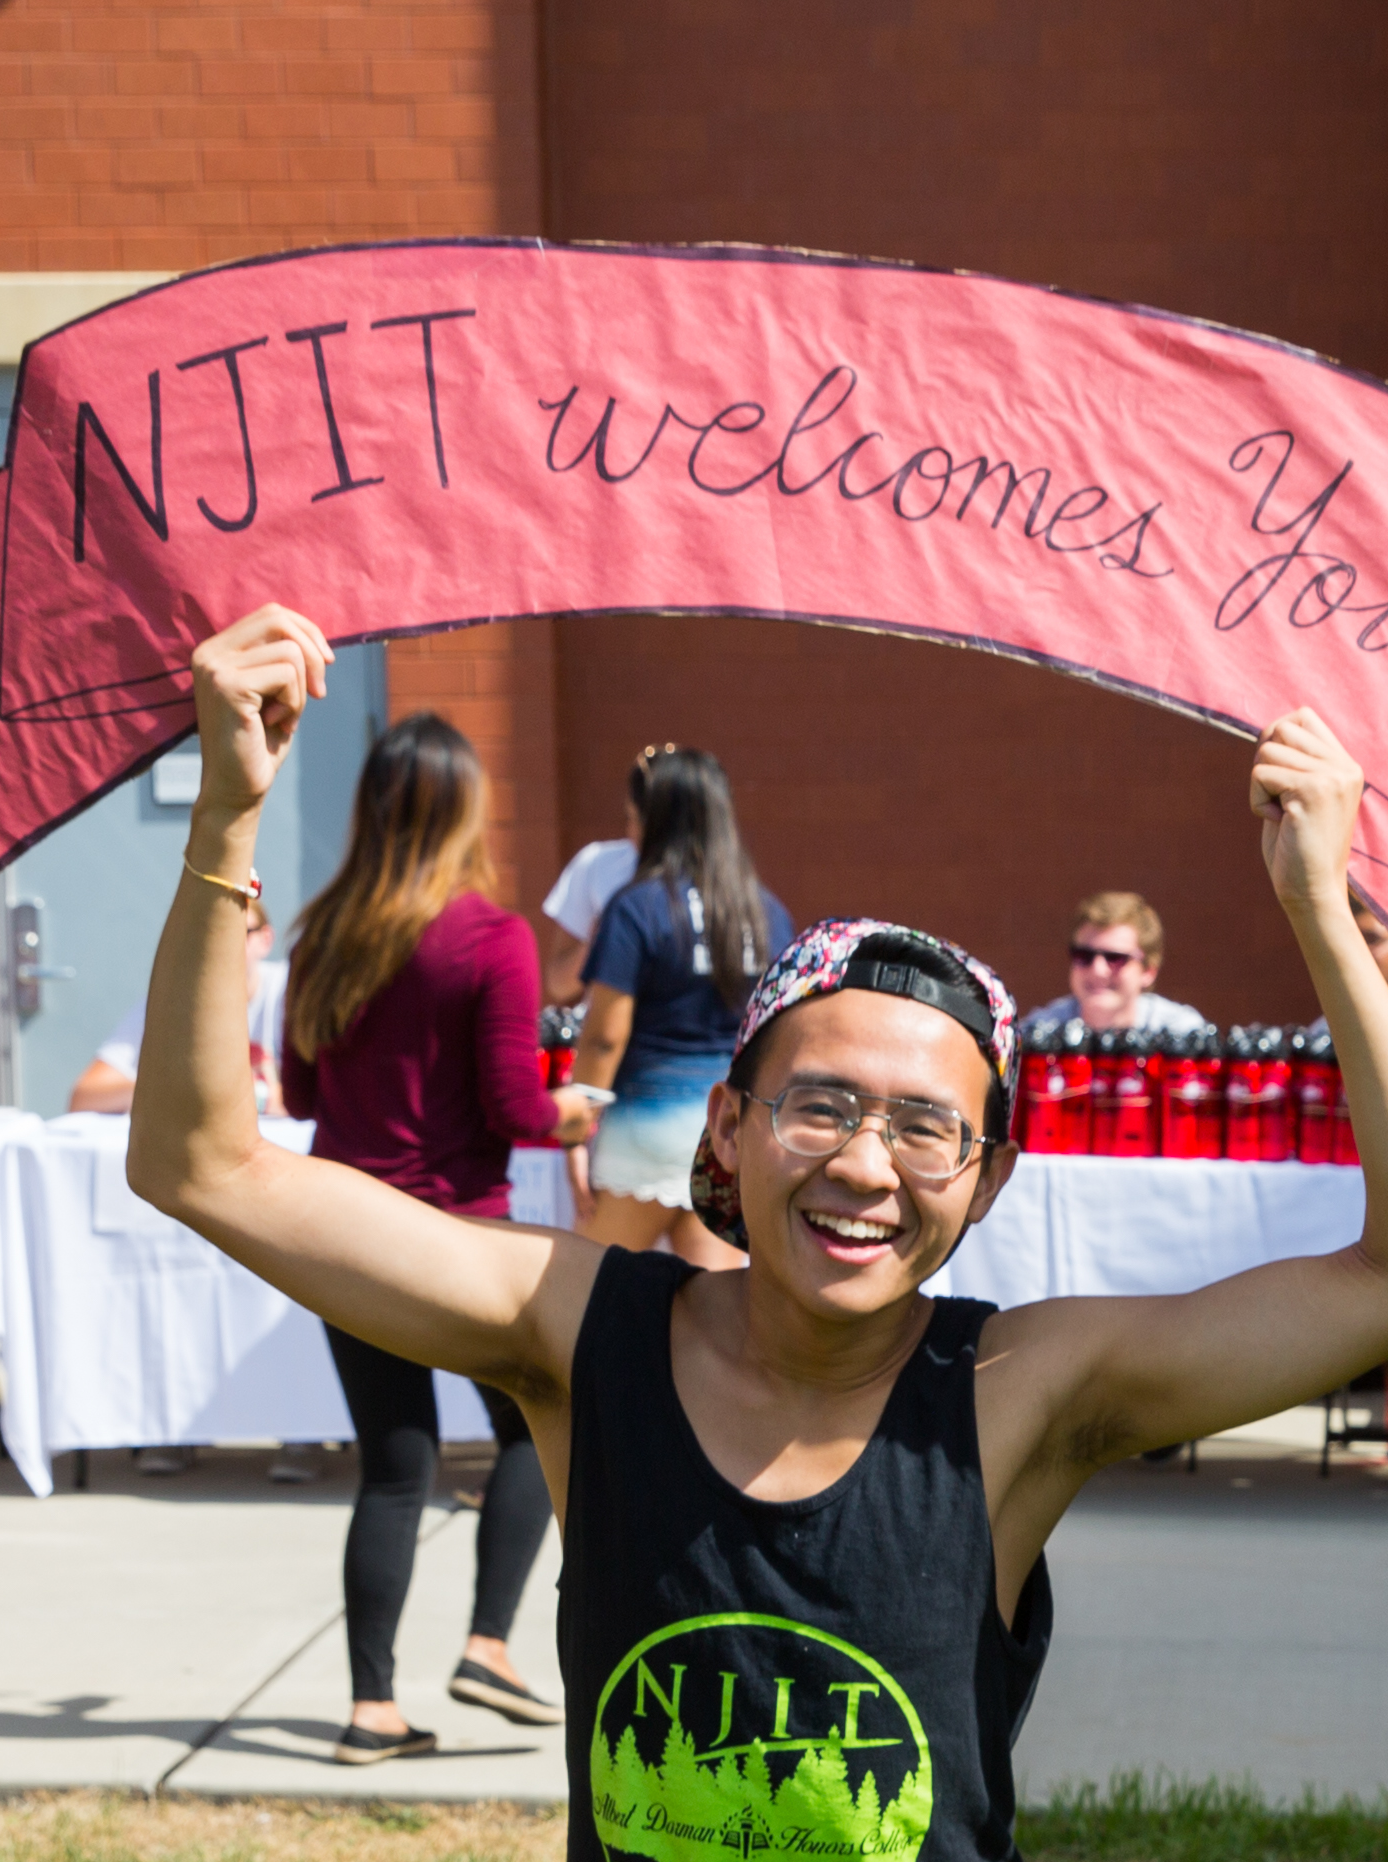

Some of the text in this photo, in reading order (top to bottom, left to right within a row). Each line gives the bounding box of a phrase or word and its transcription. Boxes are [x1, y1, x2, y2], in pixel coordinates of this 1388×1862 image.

[75, 309, 475, 562] NJIT
[538, 365, 1173, 578] welcomes
[633, 1657, 880, 1748] NJIT
[594, 1792, 637, 1829] Albert
[642, 1802, 715, 1843] Dorman
[781, 1826, 854, 1855] Honors
